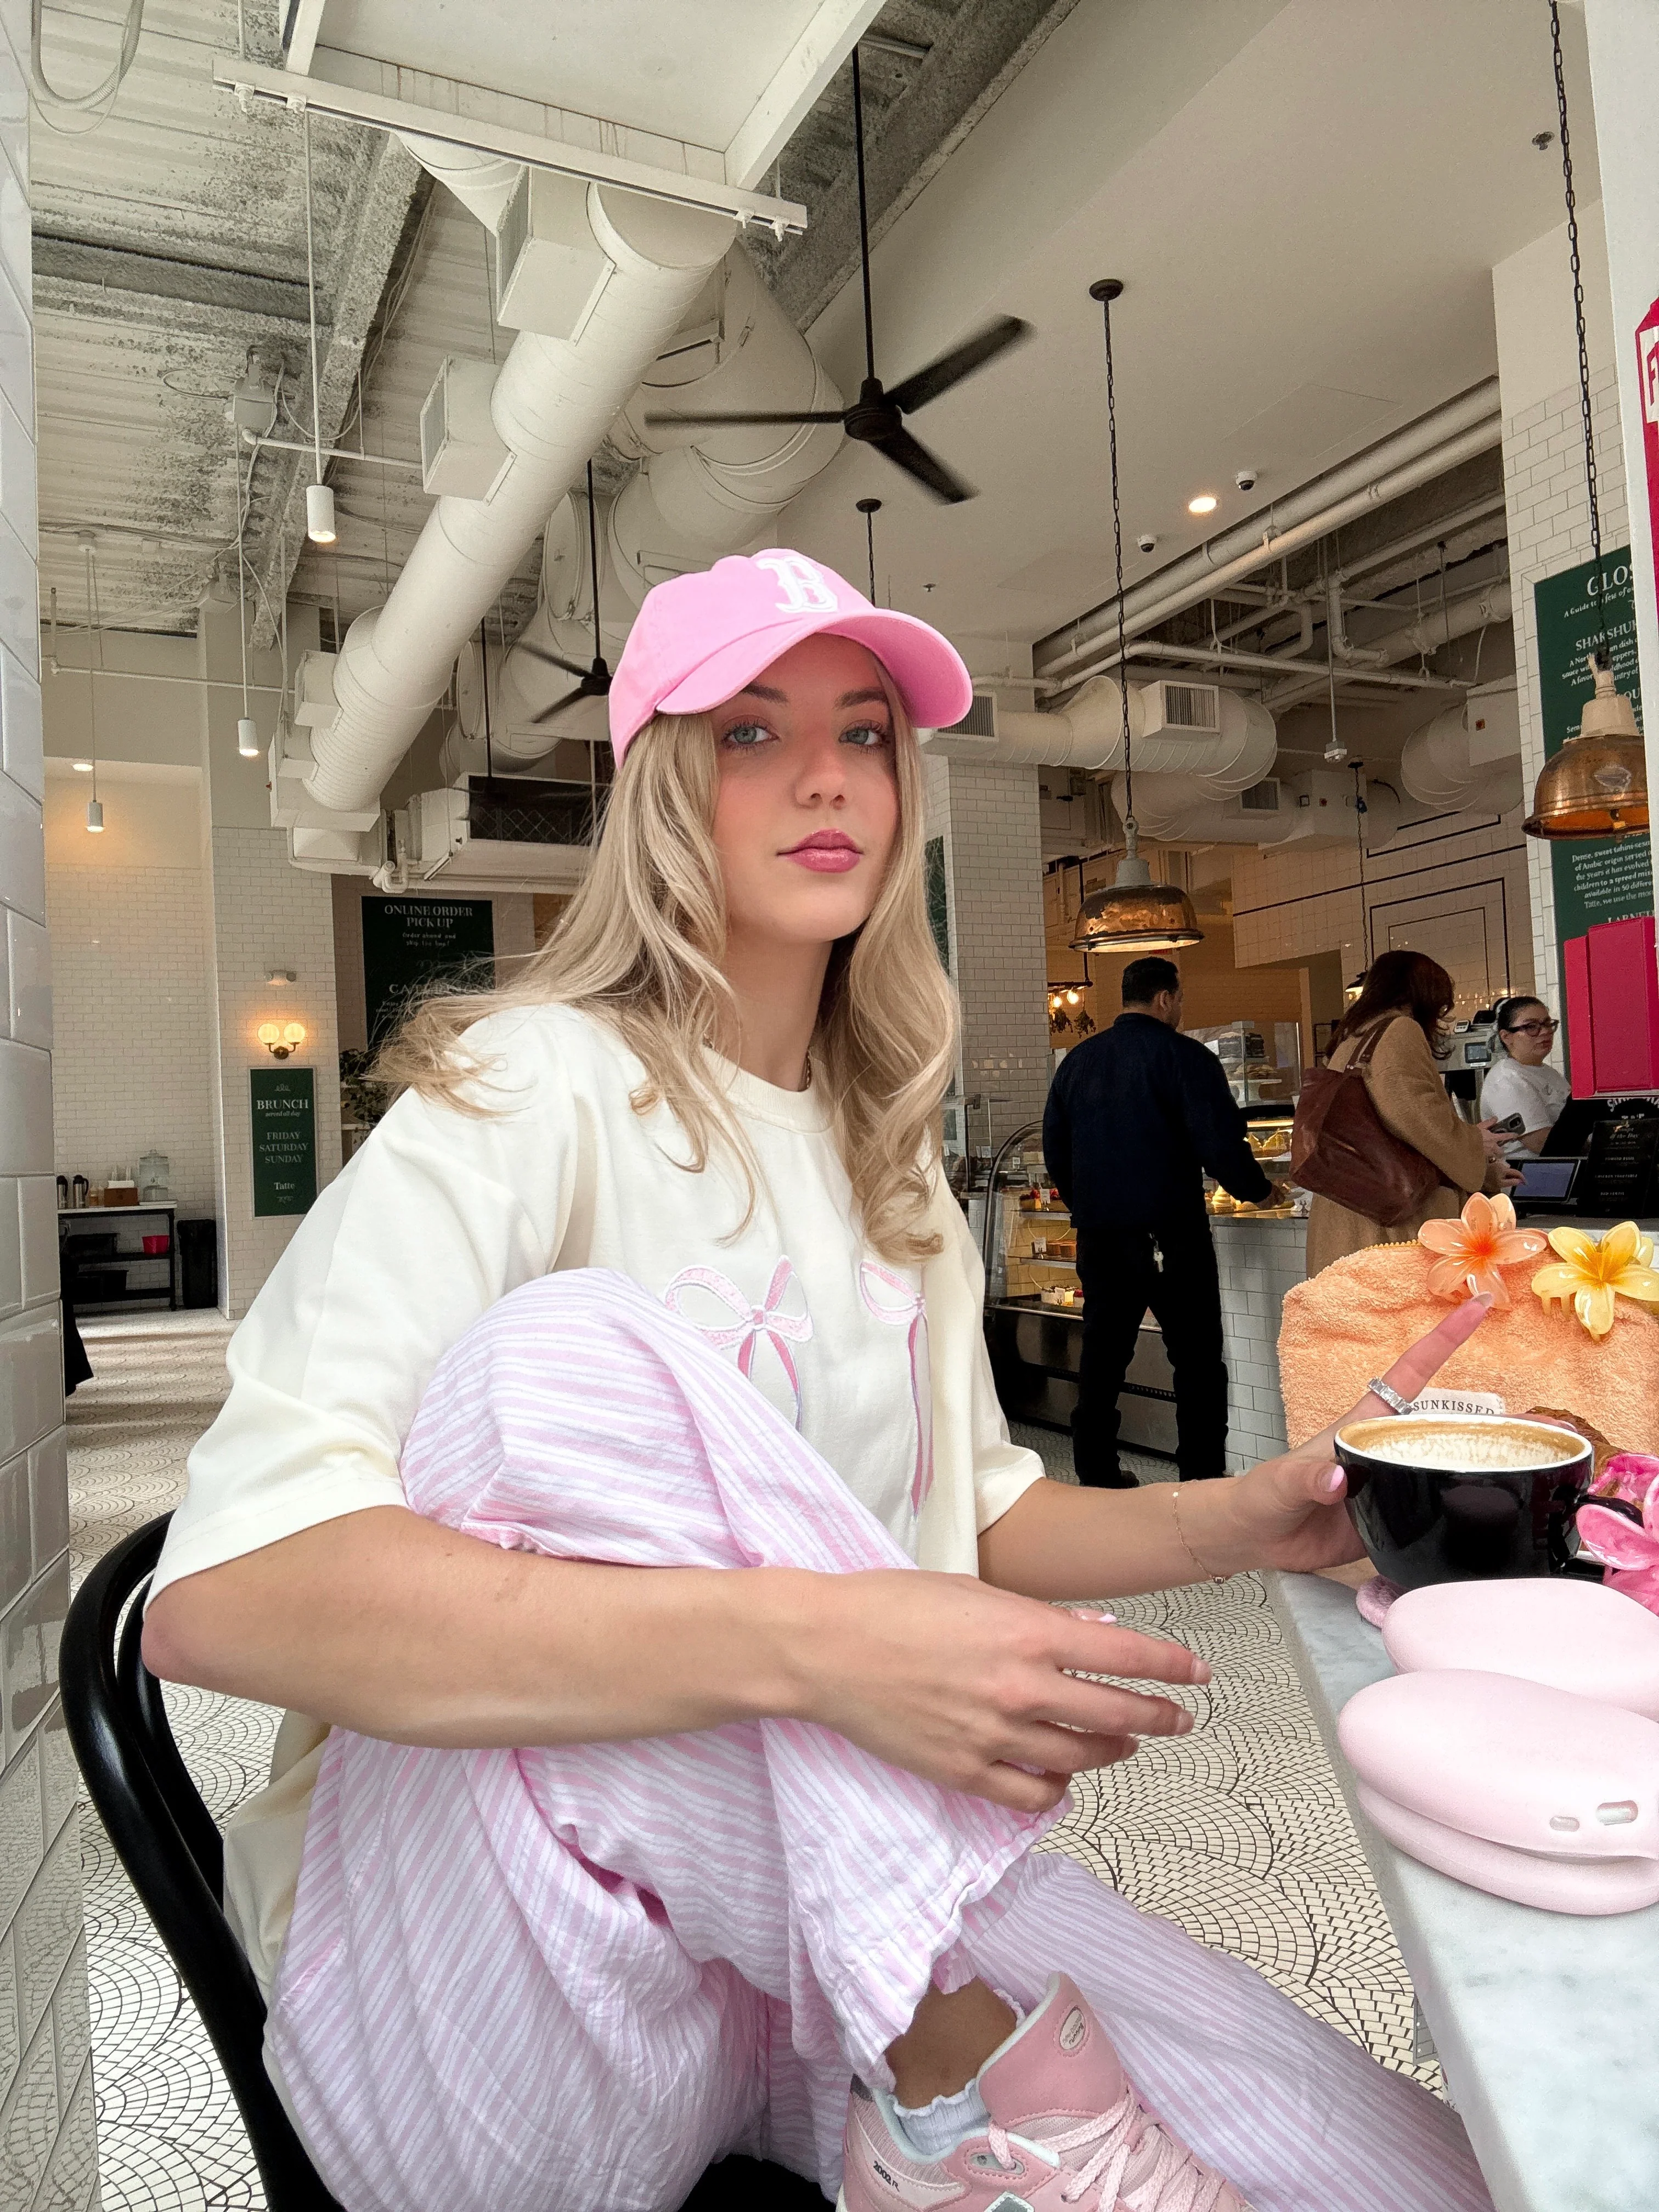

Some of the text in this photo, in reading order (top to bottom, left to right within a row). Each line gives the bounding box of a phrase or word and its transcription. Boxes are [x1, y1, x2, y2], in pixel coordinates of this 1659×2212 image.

[755, 556, 838, 613] B
[1570, 603, 1589, 615] Guide
[1619, 638, 1634, 648] dish
[385, 905, 473, 917] ONLINE ORDER
[407, 917, 454, 928] PICK UP
[256, 1099, 308, 1109] BRUNCH
[267, 1131, 301, 1140] FRIDAY
[259, 1143, 308, 1152] SATURDAY
[265, 1154, 303, 1164] SUNDAY
[1413, 1400, 1494, 1415] SUNKISSED
